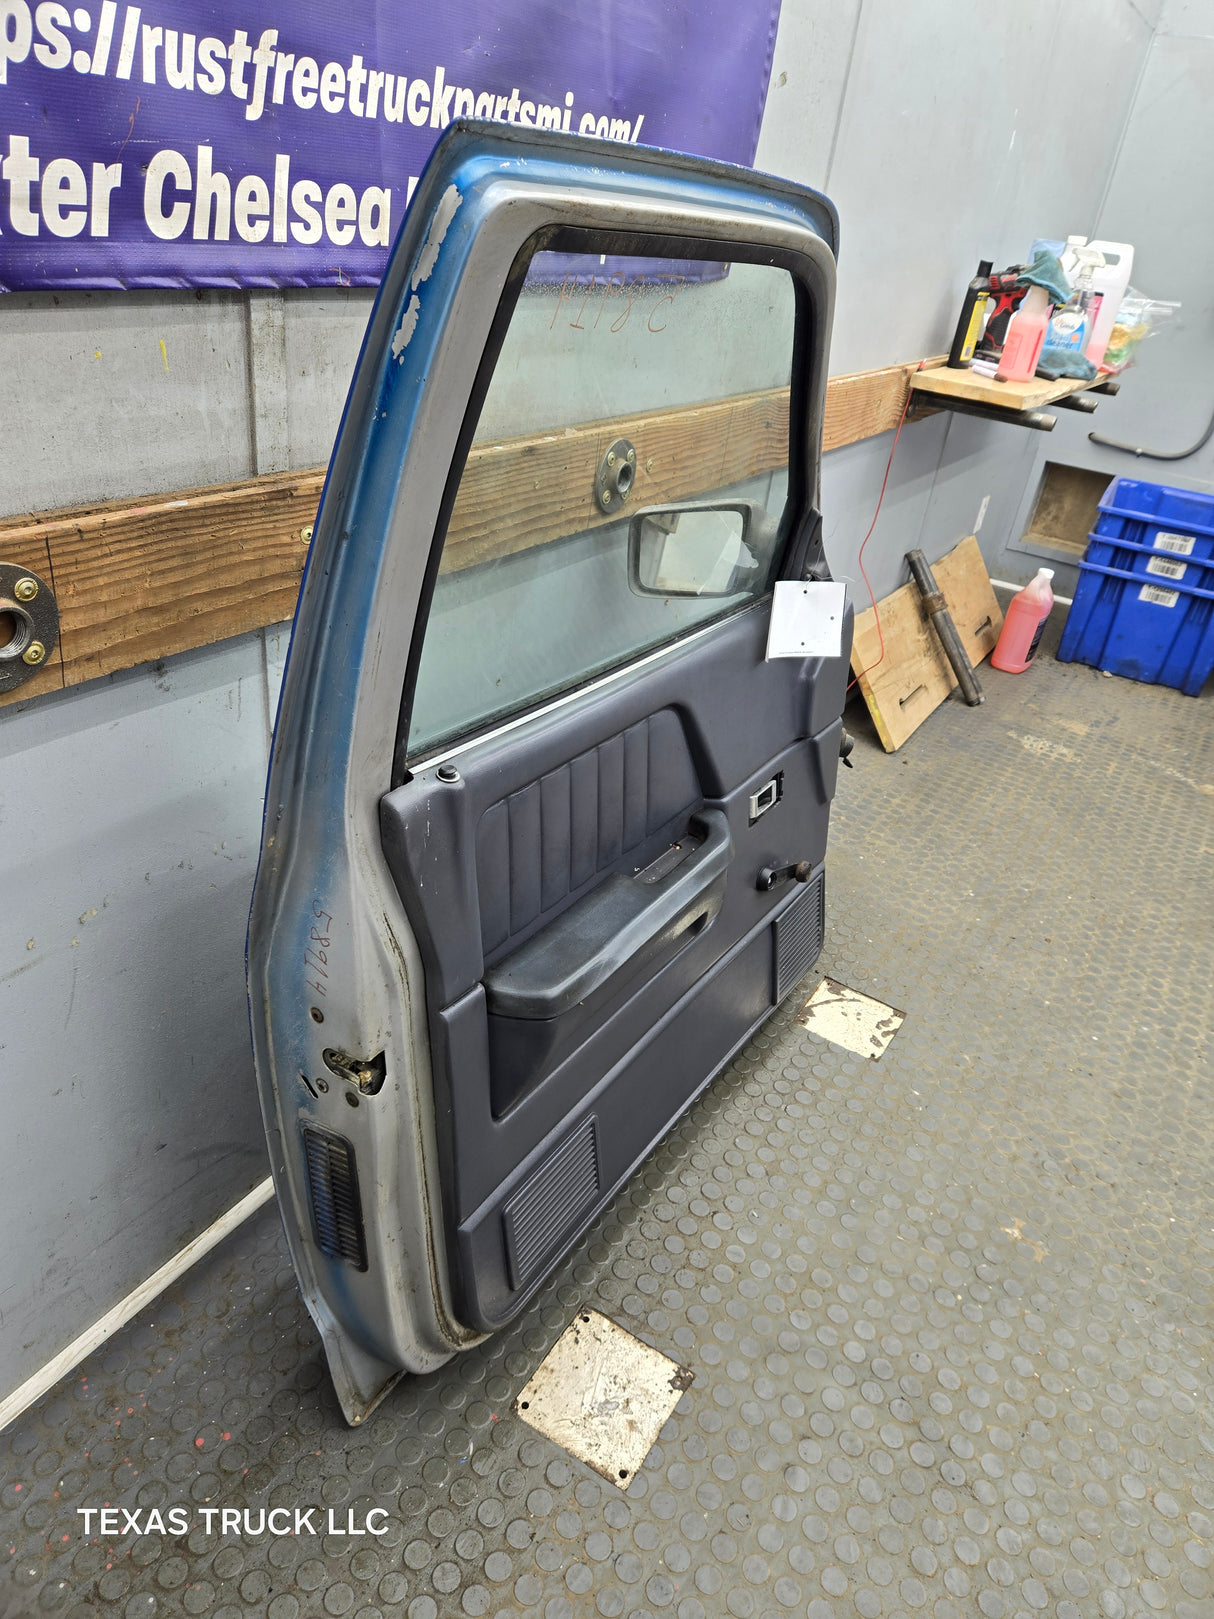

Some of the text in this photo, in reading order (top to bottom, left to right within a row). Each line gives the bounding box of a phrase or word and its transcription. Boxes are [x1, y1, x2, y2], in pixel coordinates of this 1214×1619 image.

[0, 0, 644, 143] ps://rustfreetruckpartsmicom/
[0, 135, 392, 247] ter Chelsea
